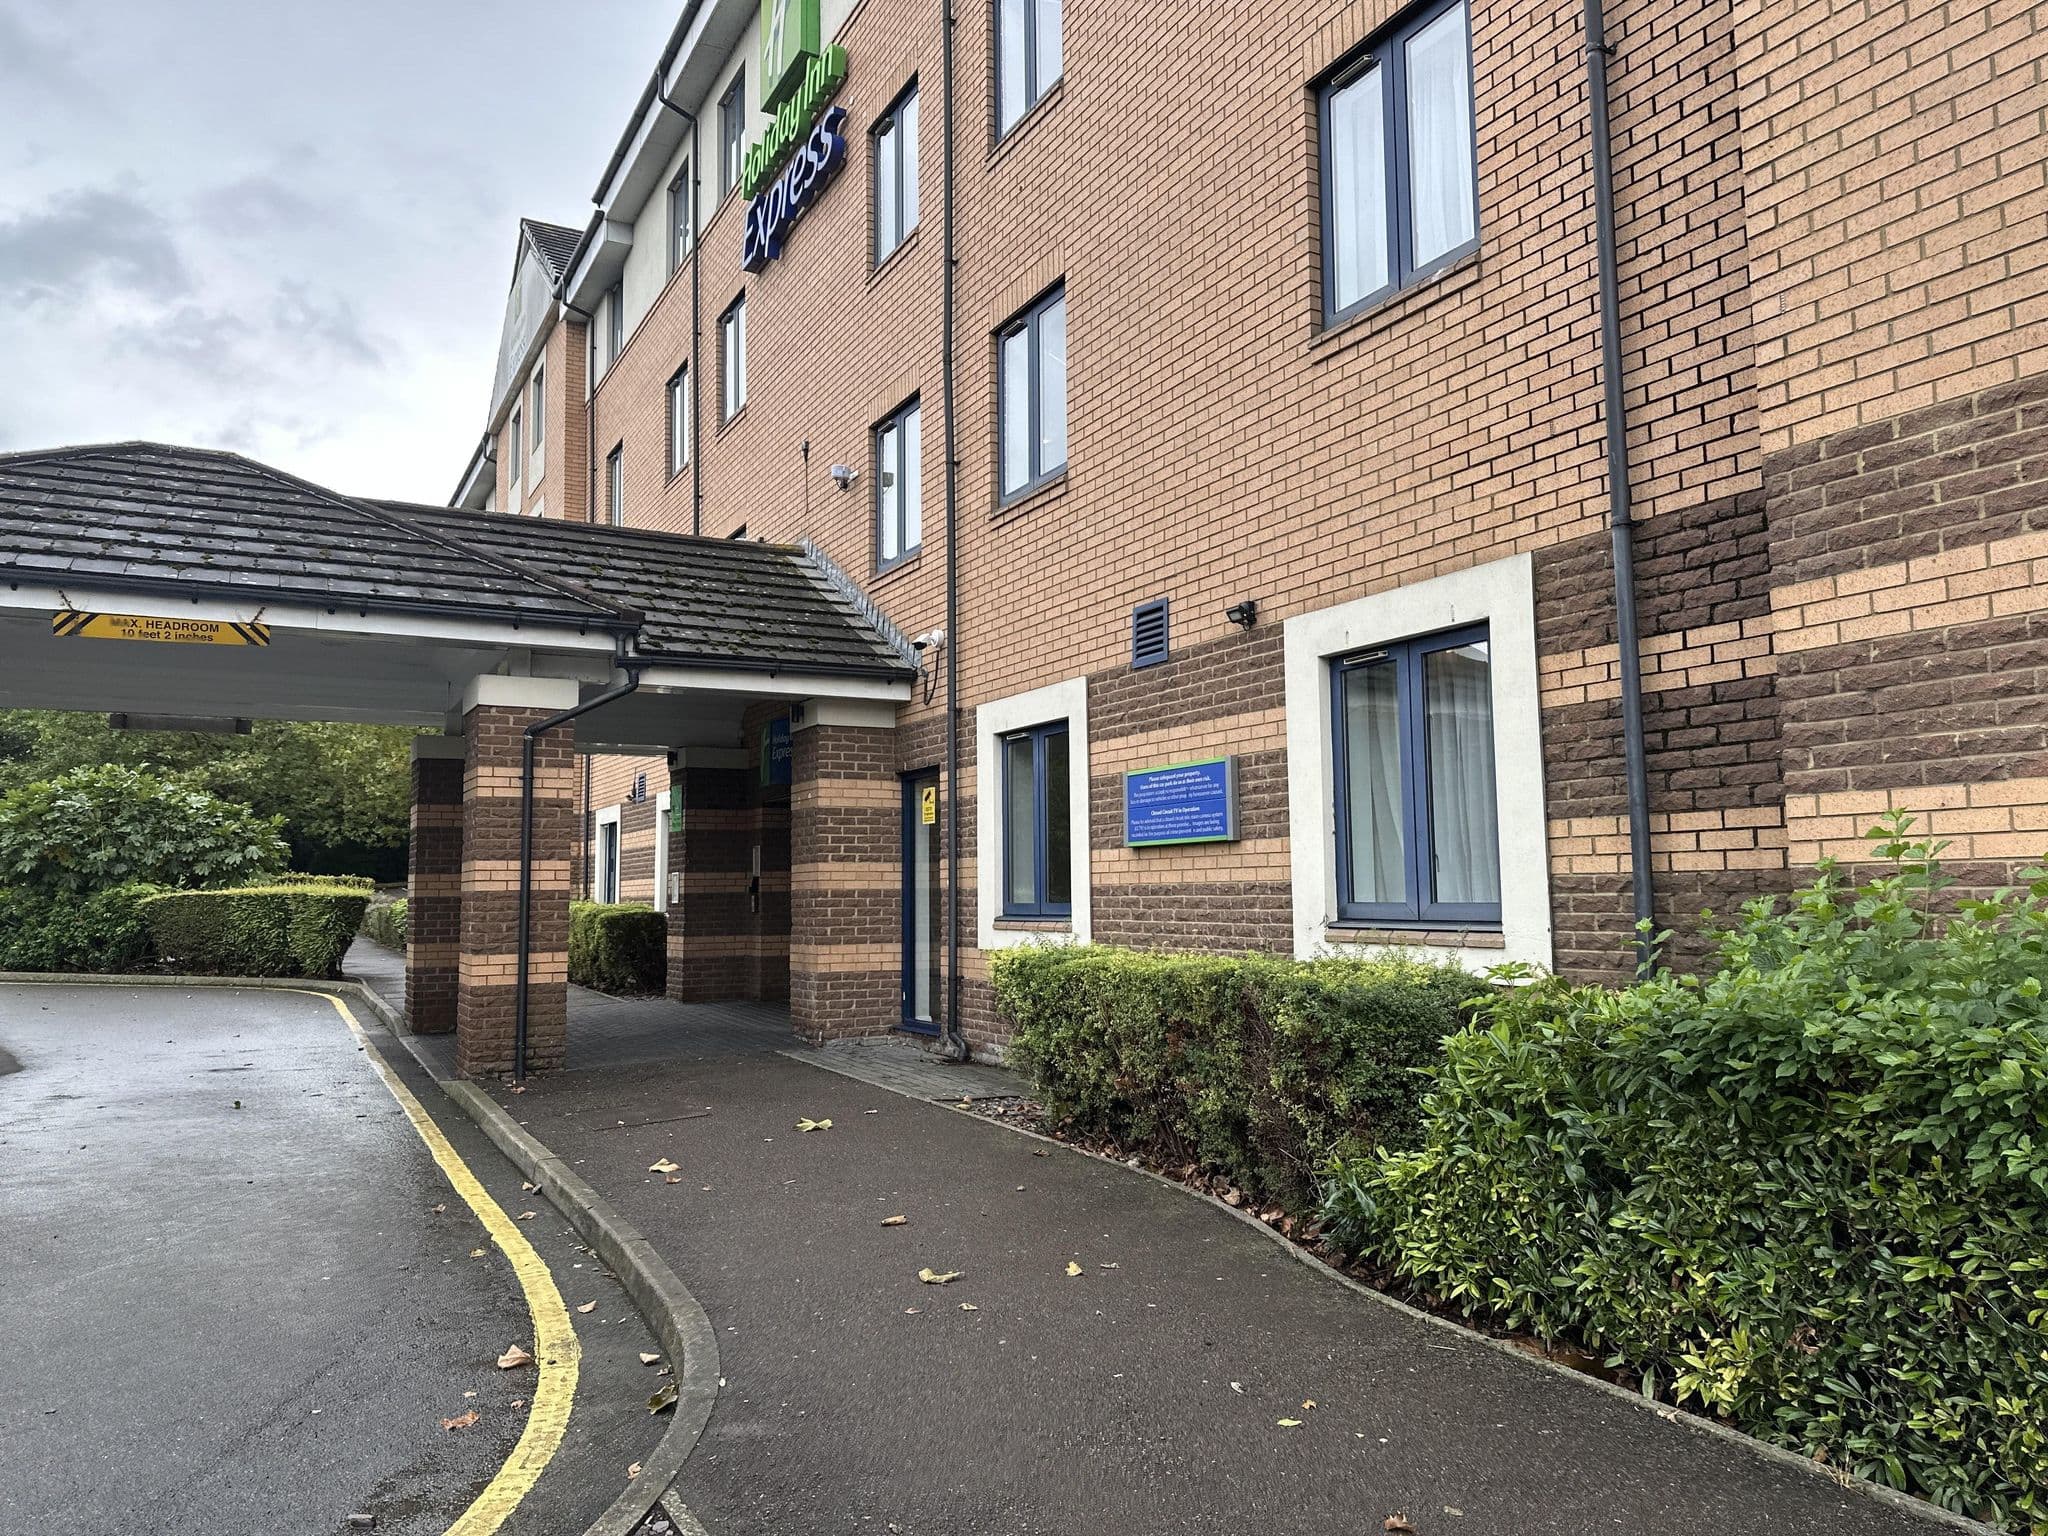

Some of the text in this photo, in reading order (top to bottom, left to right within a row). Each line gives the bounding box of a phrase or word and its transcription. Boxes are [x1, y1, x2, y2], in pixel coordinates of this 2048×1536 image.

[741, 44, 840, 198] Holiday Inn
[742, 106, 844, 272] Express
[121, 628, 214, 642] 10 feet 2 inches
[146, 620, 220, 632] HEADROOM
